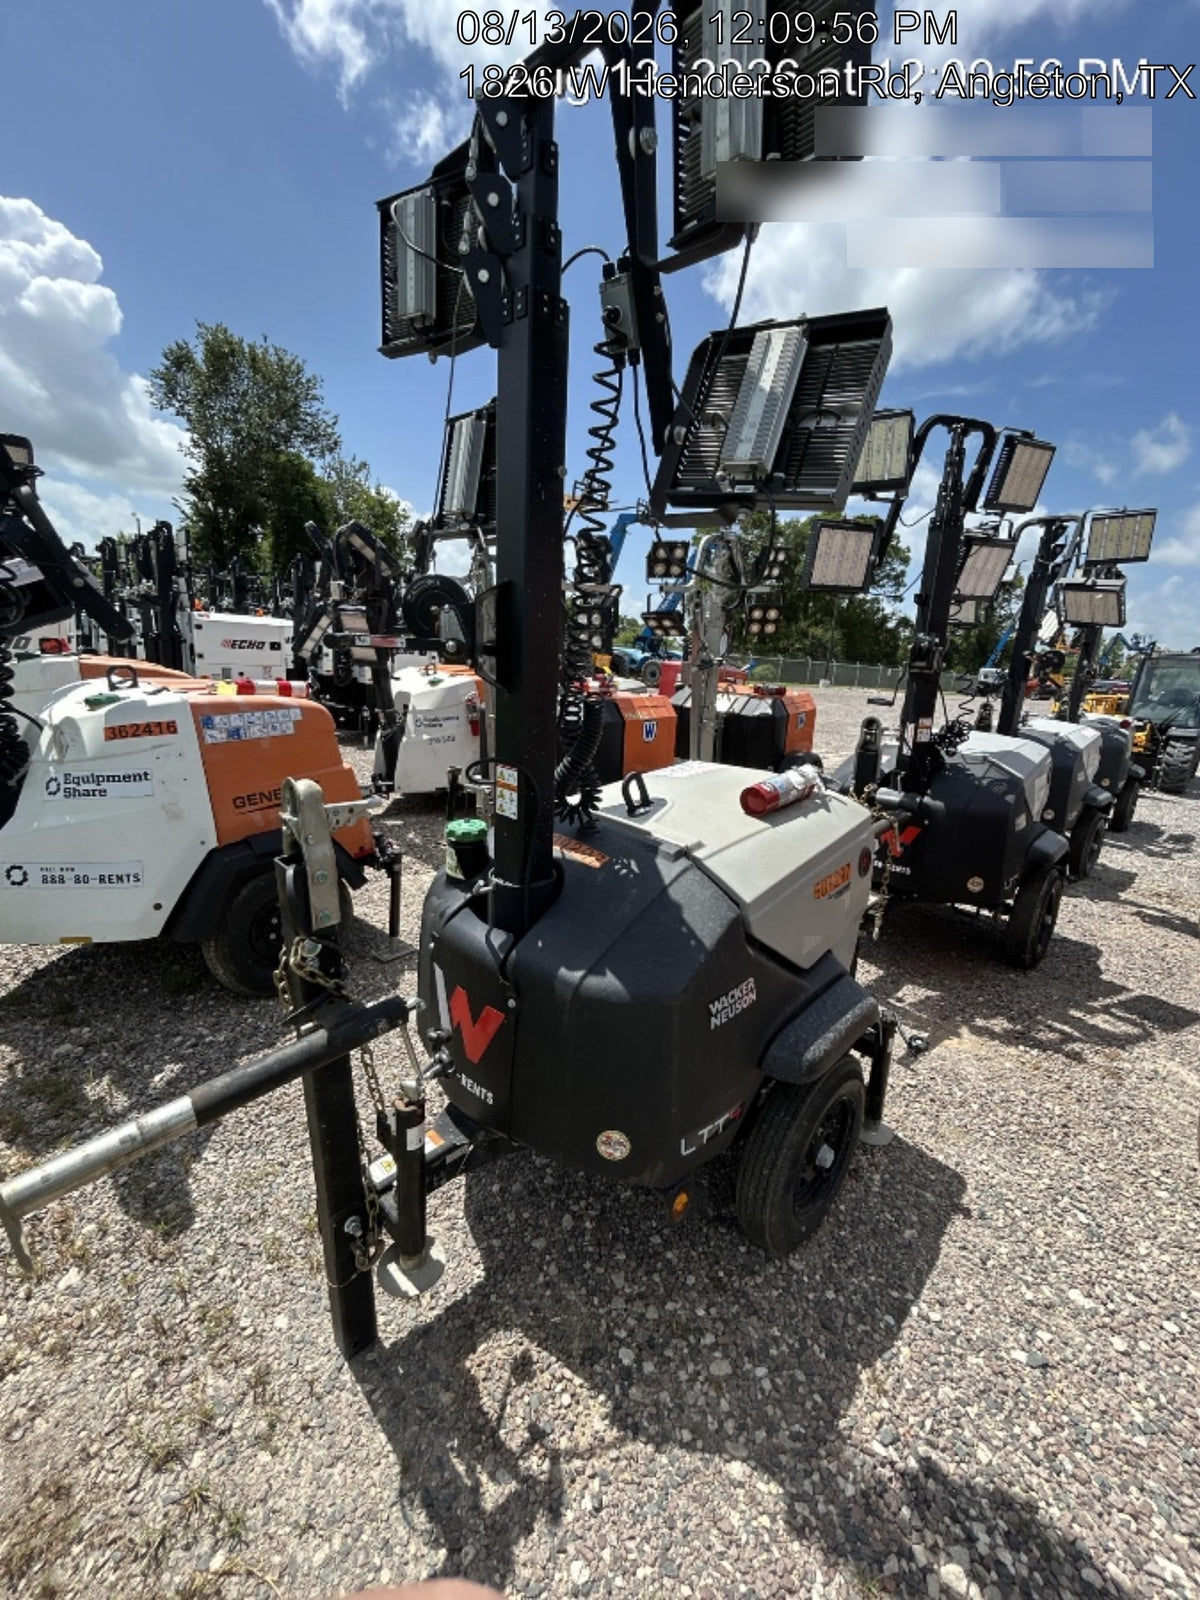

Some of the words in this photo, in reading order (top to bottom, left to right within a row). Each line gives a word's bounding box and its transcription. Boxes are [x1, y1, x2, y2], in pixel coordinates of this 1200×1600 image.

[63, 771, 150, 786] Equipment
[63, 787, 107, 798] Share
[709, 977, 755, 1015] WACKER
[710, 988, 757, 1030] NEUSON
